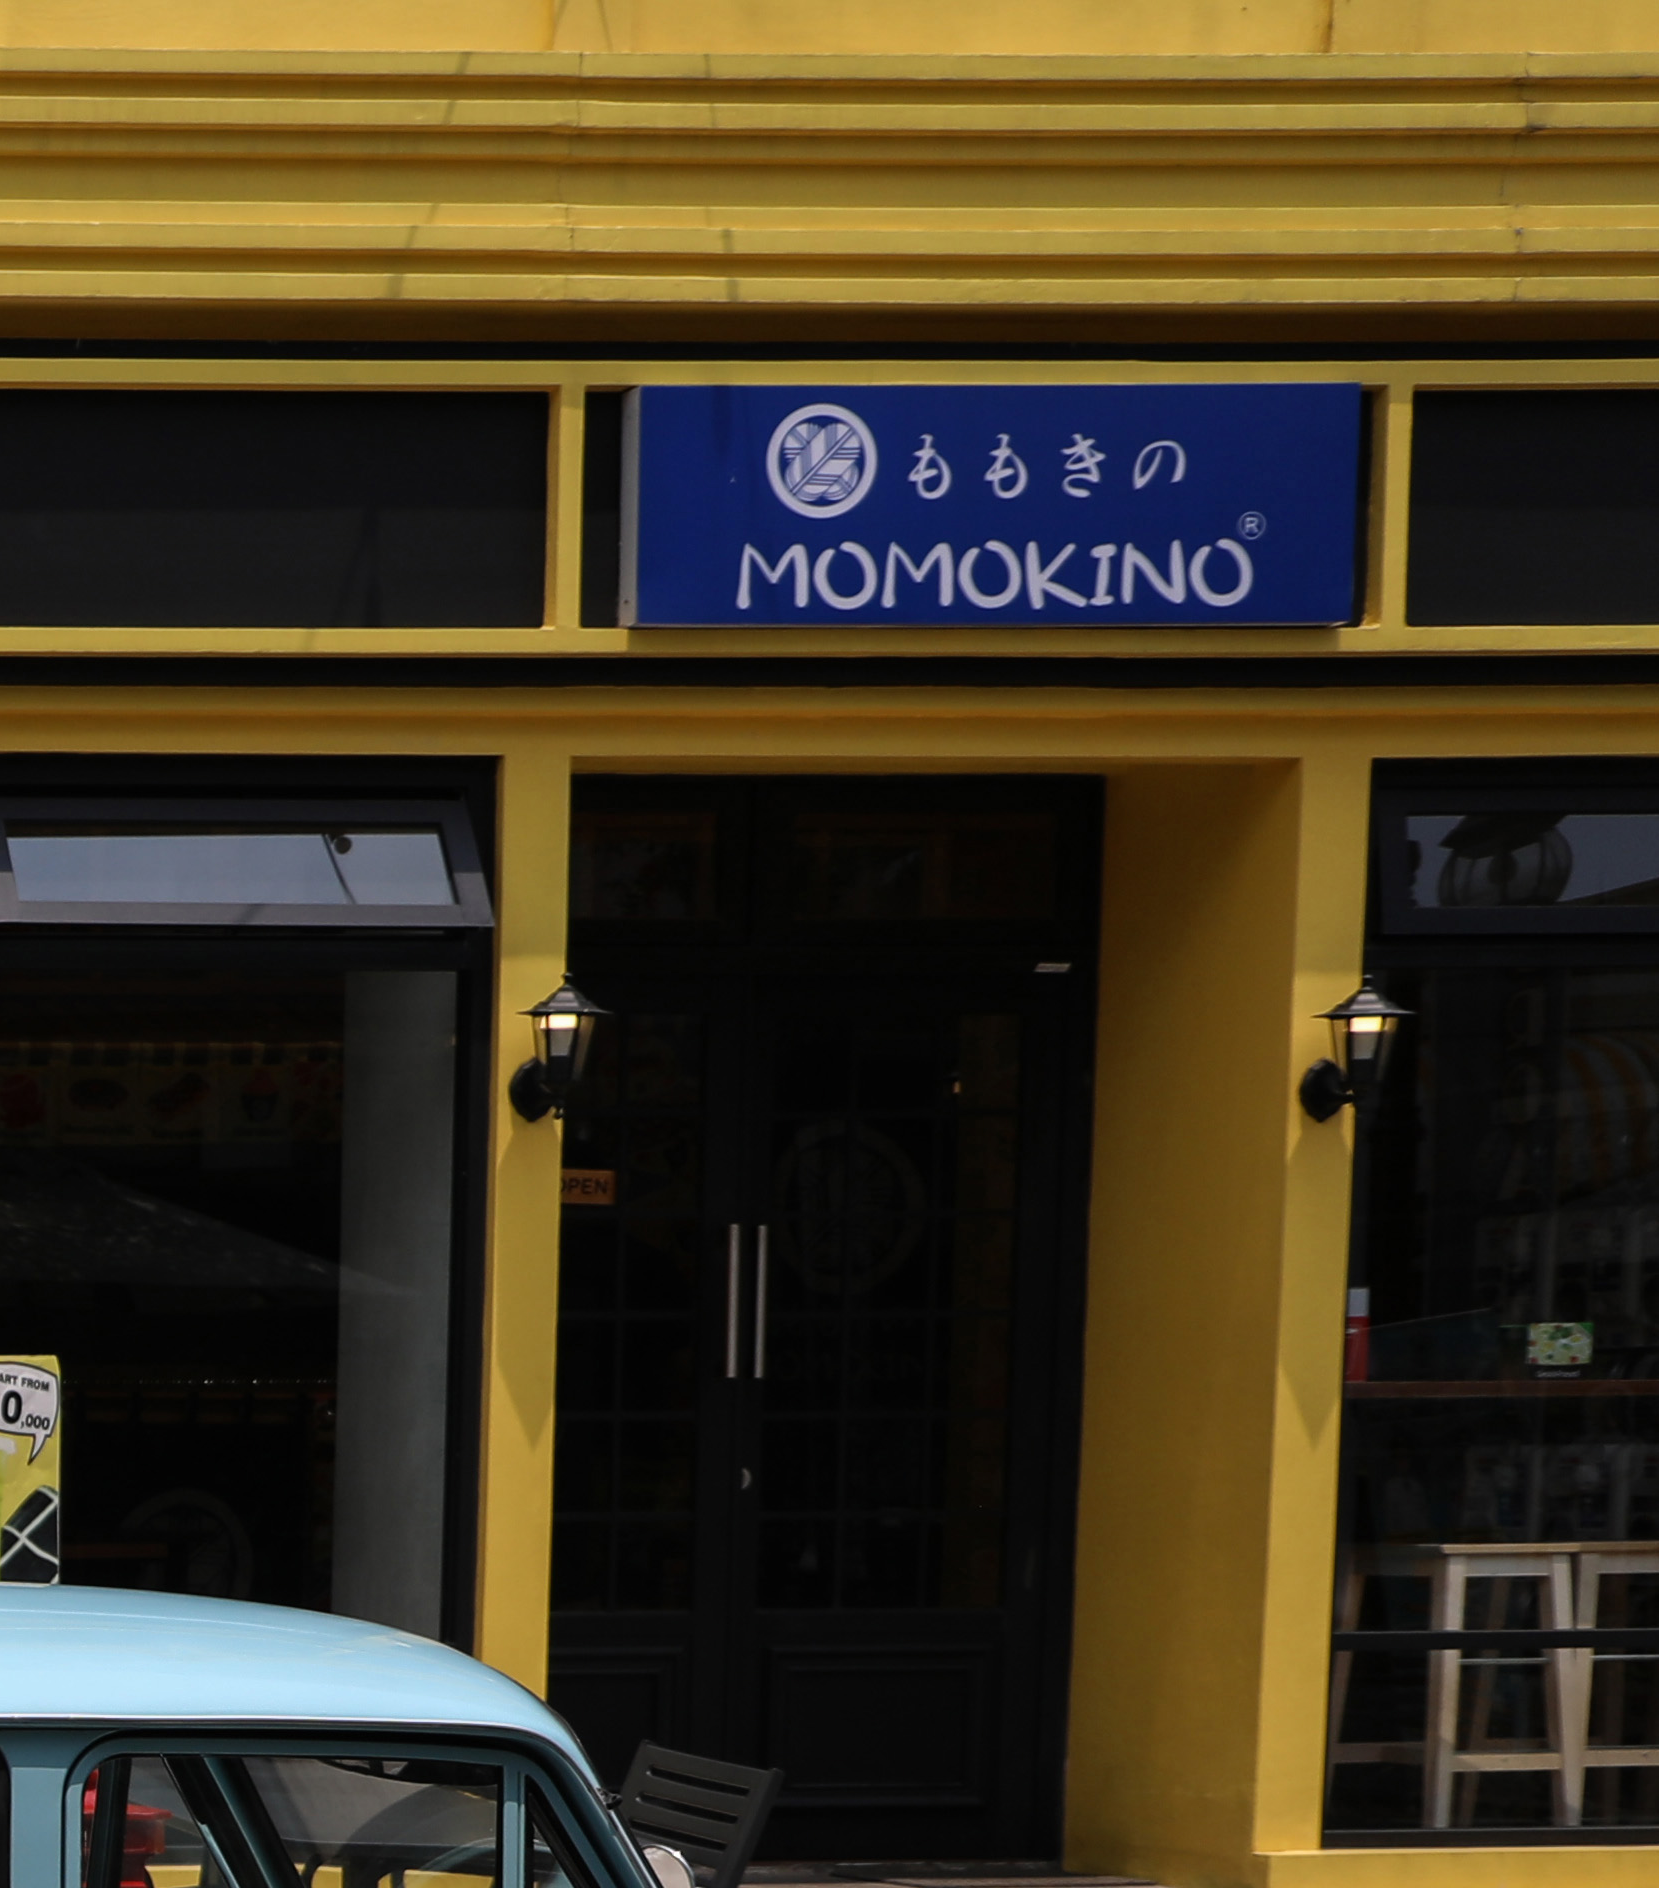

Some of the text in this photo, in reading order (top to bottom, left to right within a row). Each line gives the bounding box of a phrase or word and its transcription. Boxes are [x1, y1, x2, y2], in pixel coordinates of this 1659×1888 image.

[907, 431, 1187, 500] ももきの
[736, 535, 1254, 611] MOMOKINO
[21, 1376, 51, 1391] FROM
